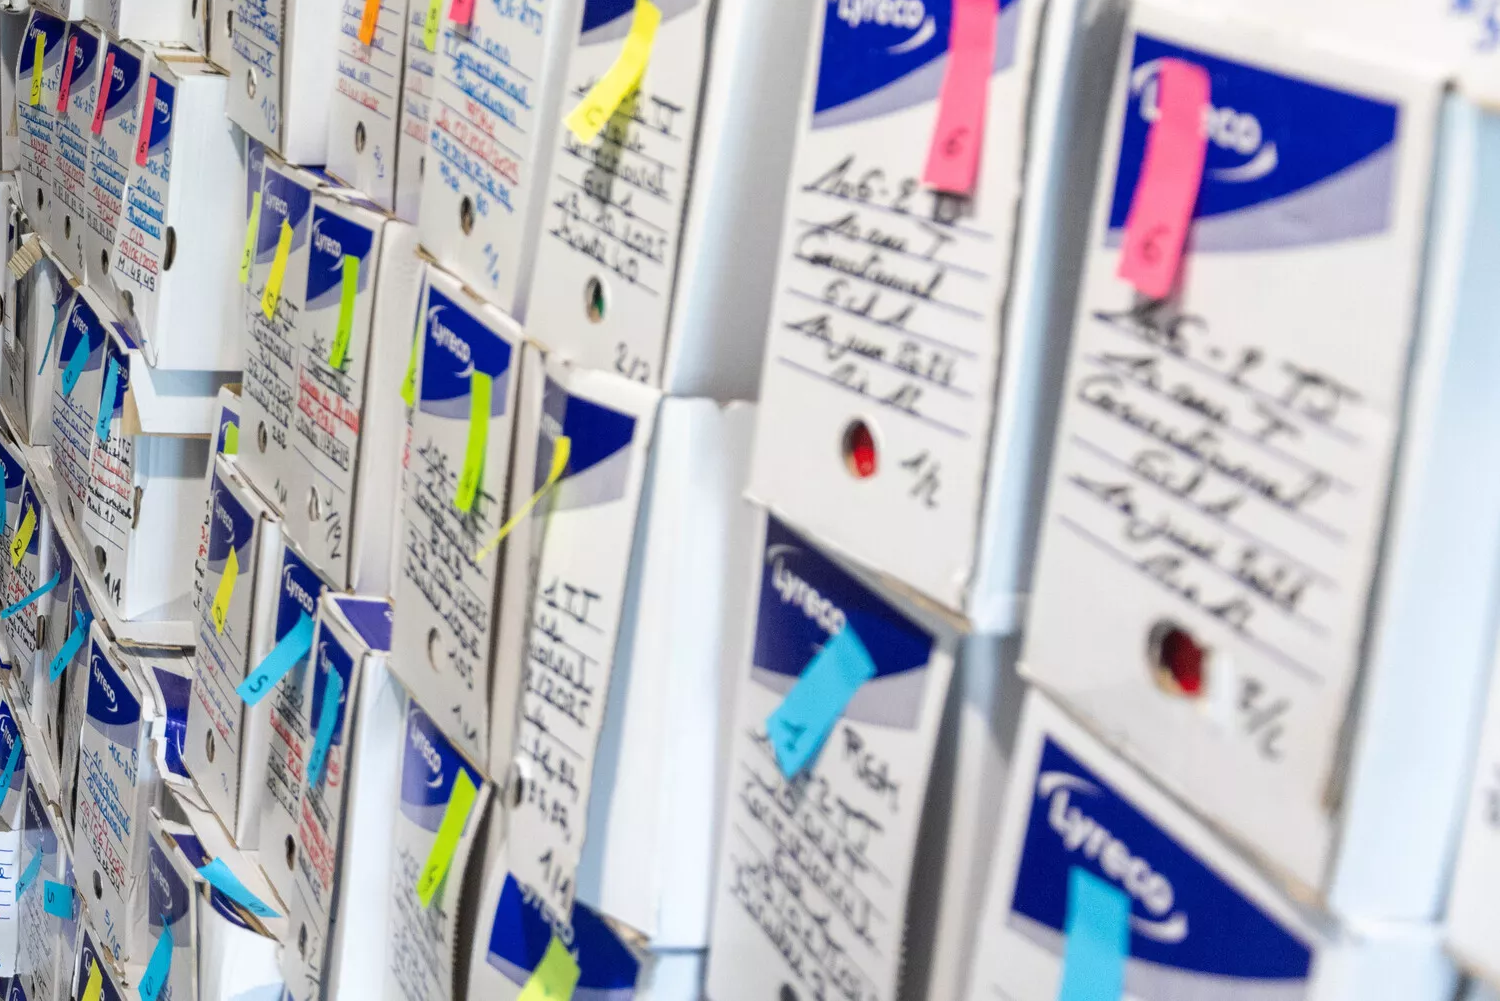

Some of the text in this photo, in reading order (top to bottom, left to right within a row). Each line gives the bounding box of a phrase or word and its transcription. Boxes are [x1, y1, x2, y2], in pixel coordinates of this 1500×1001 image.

[265, 189, 288, 215] Lyreco
[314, 228, 343, 259] Lyreco
[431, 319, 472, 363] Lyreco
[285, 573, 314, 612] Lyreco
[769, 558, 846, 636] Lyreco
[93, 663, 116, 703] Lyreco
[408, 723, 442, 775] Lyreco
[1048, 788, 1174, 917] Lyreco
[151, 862, 170, 899] Lyreco
